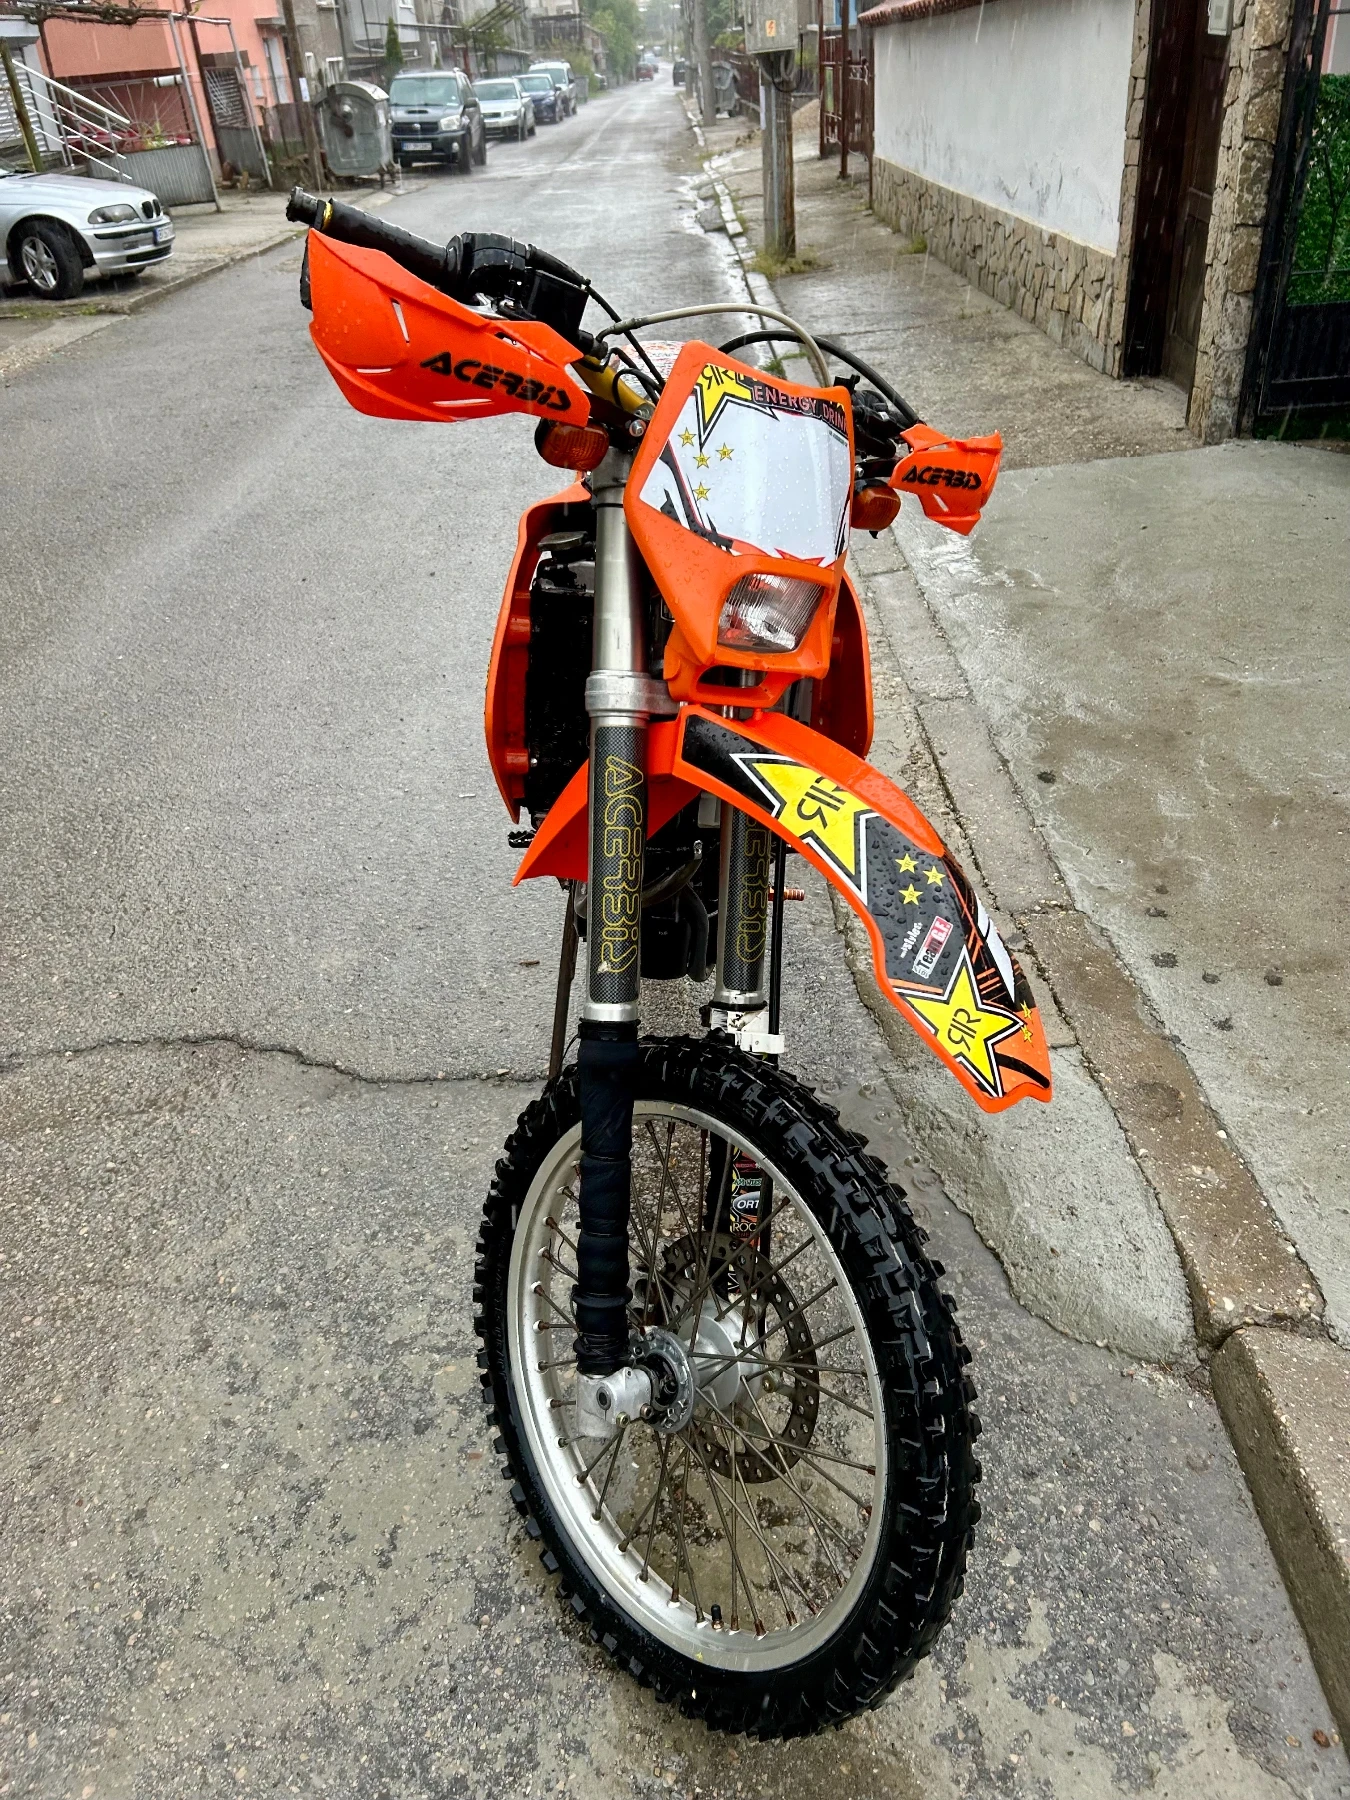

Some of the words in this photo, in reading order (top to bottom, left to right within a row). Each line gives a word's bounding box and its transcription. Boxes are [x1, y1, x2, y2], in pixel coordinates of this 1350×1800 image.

[420, 351, 572, 411] ACERBIS
[752, 385, 817, 414] ENERGY
[901, 465, 982, 490] ACERBIS
[601, 755, 644, 973] ACERBIS
[736, 818, 772, 963] ERBIS
